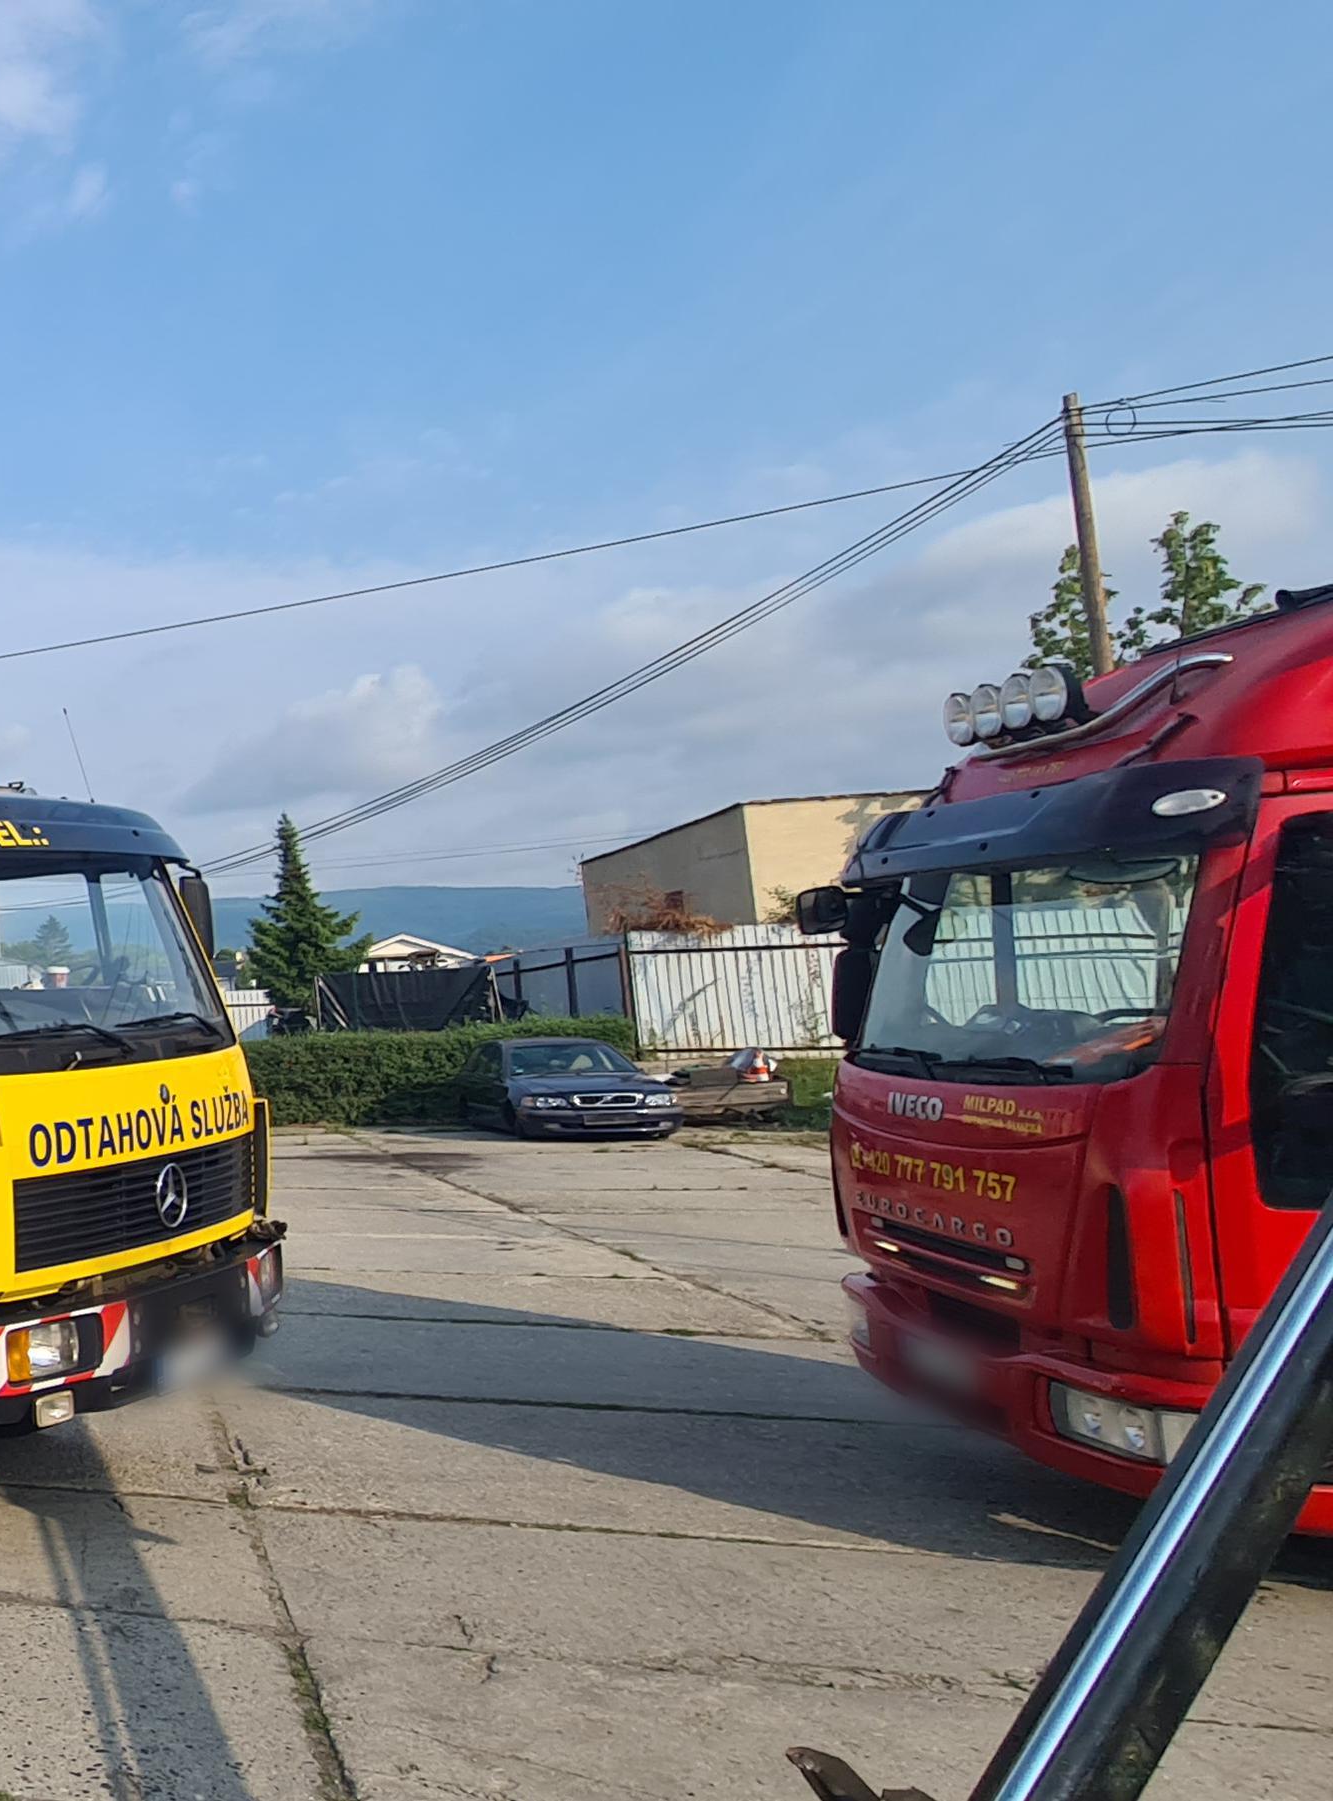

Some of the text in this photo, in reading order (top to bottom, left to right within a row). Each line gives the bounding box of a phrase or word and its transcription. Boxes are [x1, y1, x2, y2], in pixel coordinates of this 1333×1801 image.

[29, 1085, 251, 1168] ODTAHOVÁ SLUŽBA
[887, 1091, 944, 1121] IVECO
[962, 1094, 1016, 1116] MILPAD
[894, 1154, 925, 1183] 777
[930, 1161, 966, 1193] 791
[972, 1169, 1016, 1202] 757
[855, 1190, 1014, 1247] EUROCARGO
